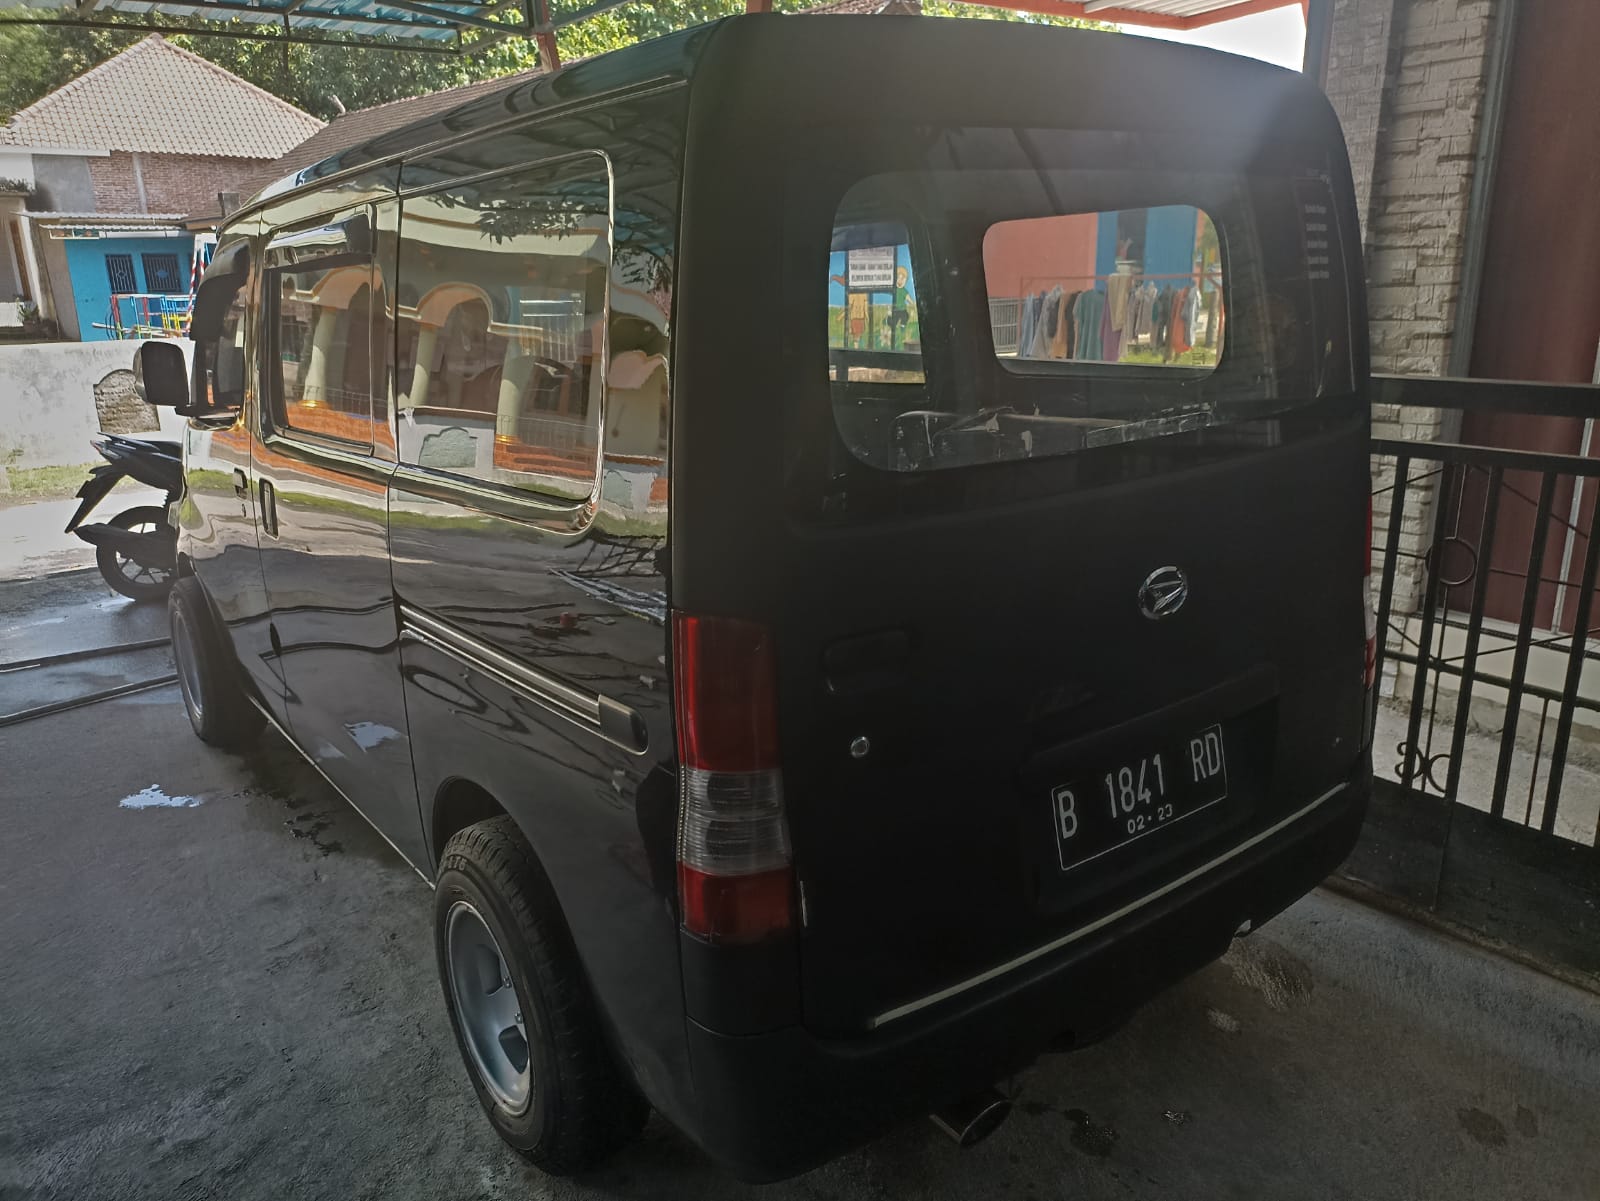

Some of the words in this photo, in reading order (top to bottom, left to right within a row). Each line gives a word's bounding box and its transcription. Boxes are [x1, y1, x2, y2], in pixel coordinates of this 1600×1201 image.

[1057, 790, 1078, 839] B
[1104, 753, 1164, 819] 1841
[1190, 731, 1221, 782] RD
